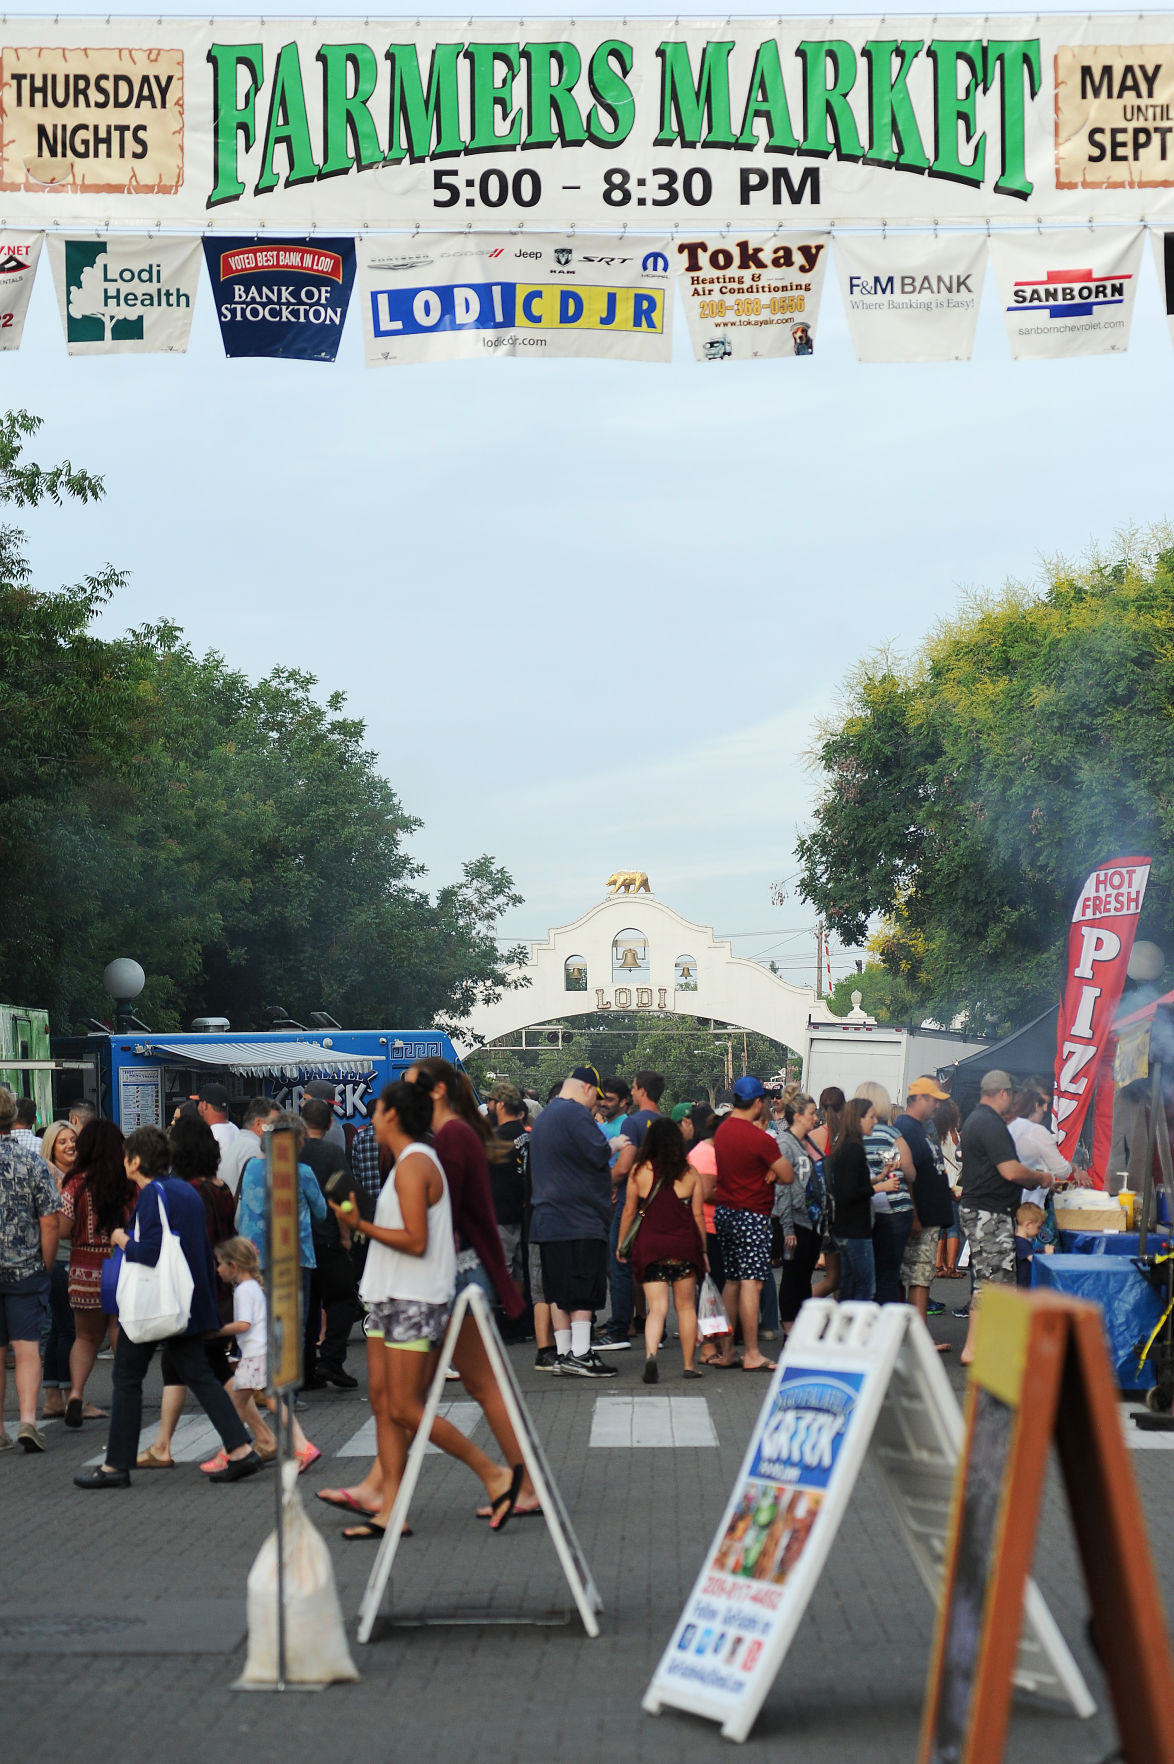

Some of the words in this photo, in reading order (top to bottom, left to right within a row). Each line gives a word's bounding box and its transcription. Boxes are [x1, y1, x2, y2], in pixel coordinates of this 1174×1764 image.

[11, 73, 174, 109] THURSDAY
[1081, 64, 1162, 99] MAY
[206, 39, 636, 209] FARMERS
[653, 38, 1041, 202] MARKET
[1123, 104, 1174, 122] UNTIL
[37, 123, 148, 159] NIGHTS
[1088, 127, 1173, 162] SEPT
[433, 169, 542, 208] 5:00
[602, 167, 713, 207] 8:30
[739, 167, 821, 206] PM
[228, 252, 256, 271] VOTED
[256, 251, 278, 267] BEST
[279, 251, 302, 267] BANK
[303, 253, 313, 269] IN
[313, 254, 335, 273] LODI
[515, 249, 542, 260] Jeep
[578, 256, 633, 265] SRT
[677, 240, 825, 274] Tokay
[103, 263, 162, 284] Lodi
[690, 274, 745, 285] Heating
[751, 273, 762, 282] &
[849, 275, 895, 295] F&M
[900, 274, 974, 294] BANK
[103, 288, 190, 308] Health
[233, 285, 297, 303] BANK
[300, 286, 331, 304] OF
[691, 286, 714, 297] Air
[719, 282, 812, 295] Conditioning
[1013, 282, 1124, 304] SANBORN
[221, 304, 342, 325] STOCKTON
[376, 285, 504, 331] LODI
[522, 289, 657, 330] CDJR
[699, 295, 806, 318] 209-368-0556
[850, 299, 885, 310] Where
[887, 299, 933, 311] Banking
[935, 299, 945, 309] is
[946, 298, 975, 310] Easy!
[714, 316, 795, 328] www.tokayair.com
[1018, 319, 1125, 336] sanbornchevrolet.com
[1094, 869, 1137, 893] HOT
[1081, 890, 1141, 917] FRESH
[595, 987, 667, 1010] LODI
